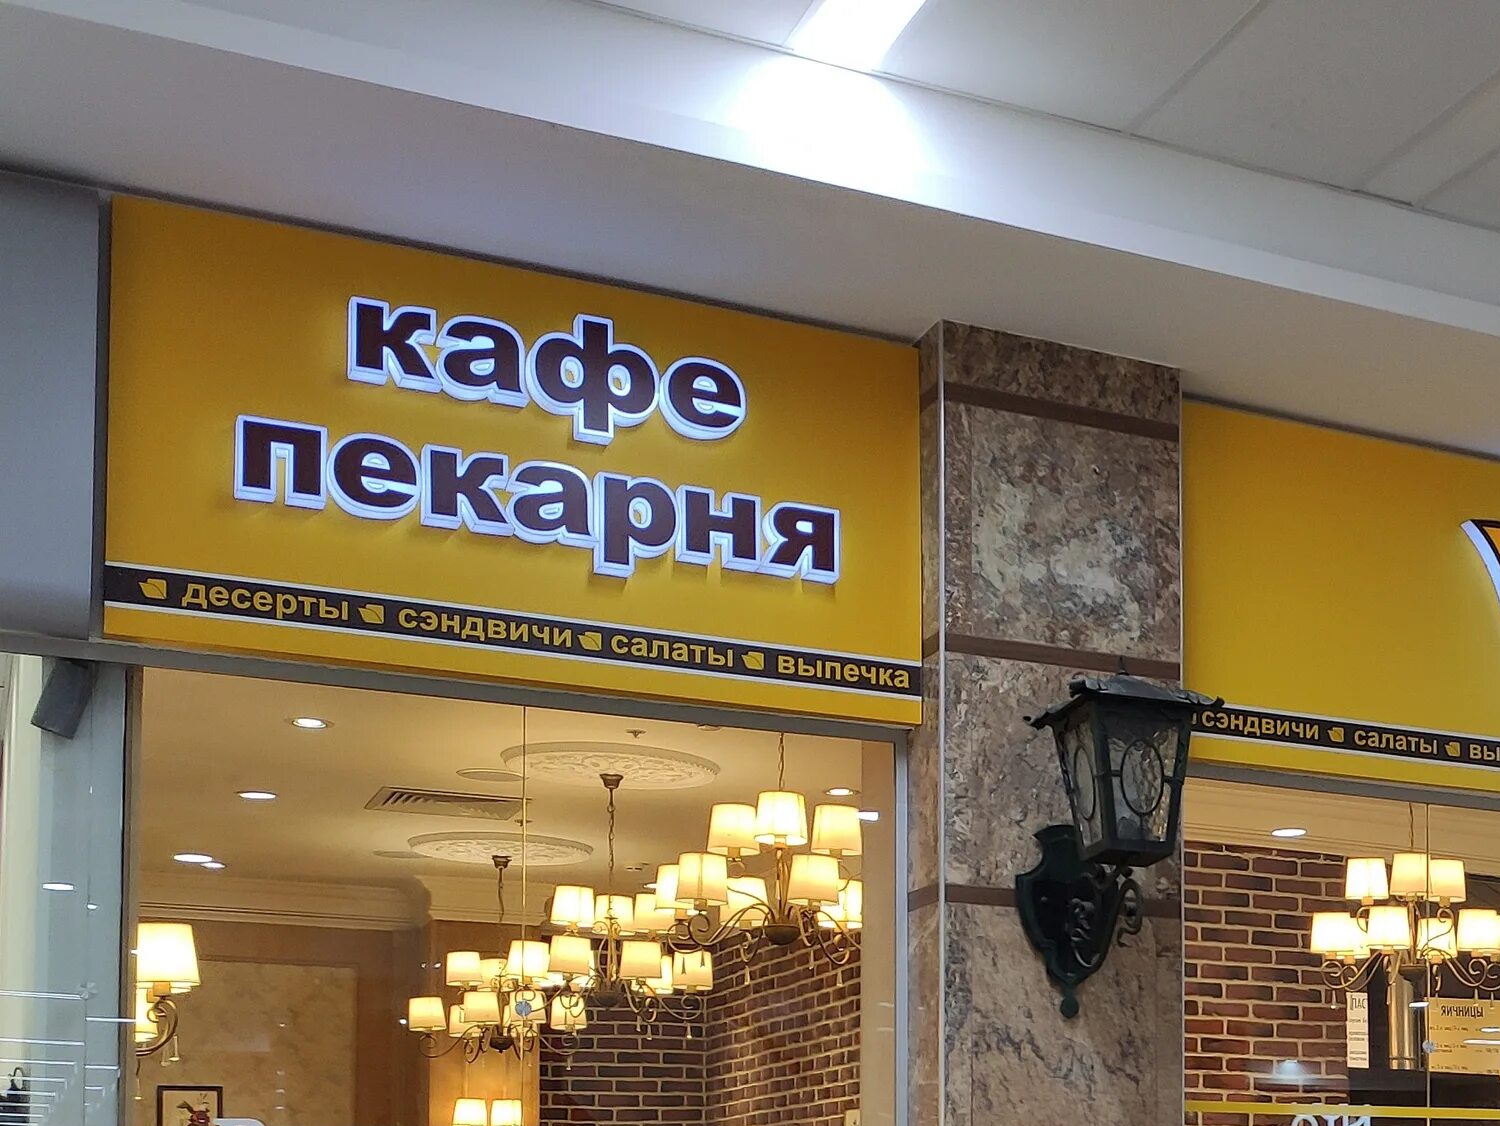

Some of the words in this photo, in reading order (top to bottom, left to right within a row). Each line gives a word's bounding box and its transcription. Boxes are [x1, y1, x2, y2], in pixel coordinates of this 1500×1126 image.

[347, 296, 747, 443] кафе
[234, 414, 843, 586] пекарня
[181, 583, 348, 620] десерты
[398, 607, 572, 648] сэндвичи
[610, 631, 733, 667] салаты
[777, 654, 911, 690] выпечка
[1201, 710, 1319, 740] сэндвичи
[1354, 730, 1438, 755] салаты
[1441, 1005, 1484, 1018] ЯИЧНИЦЫ
